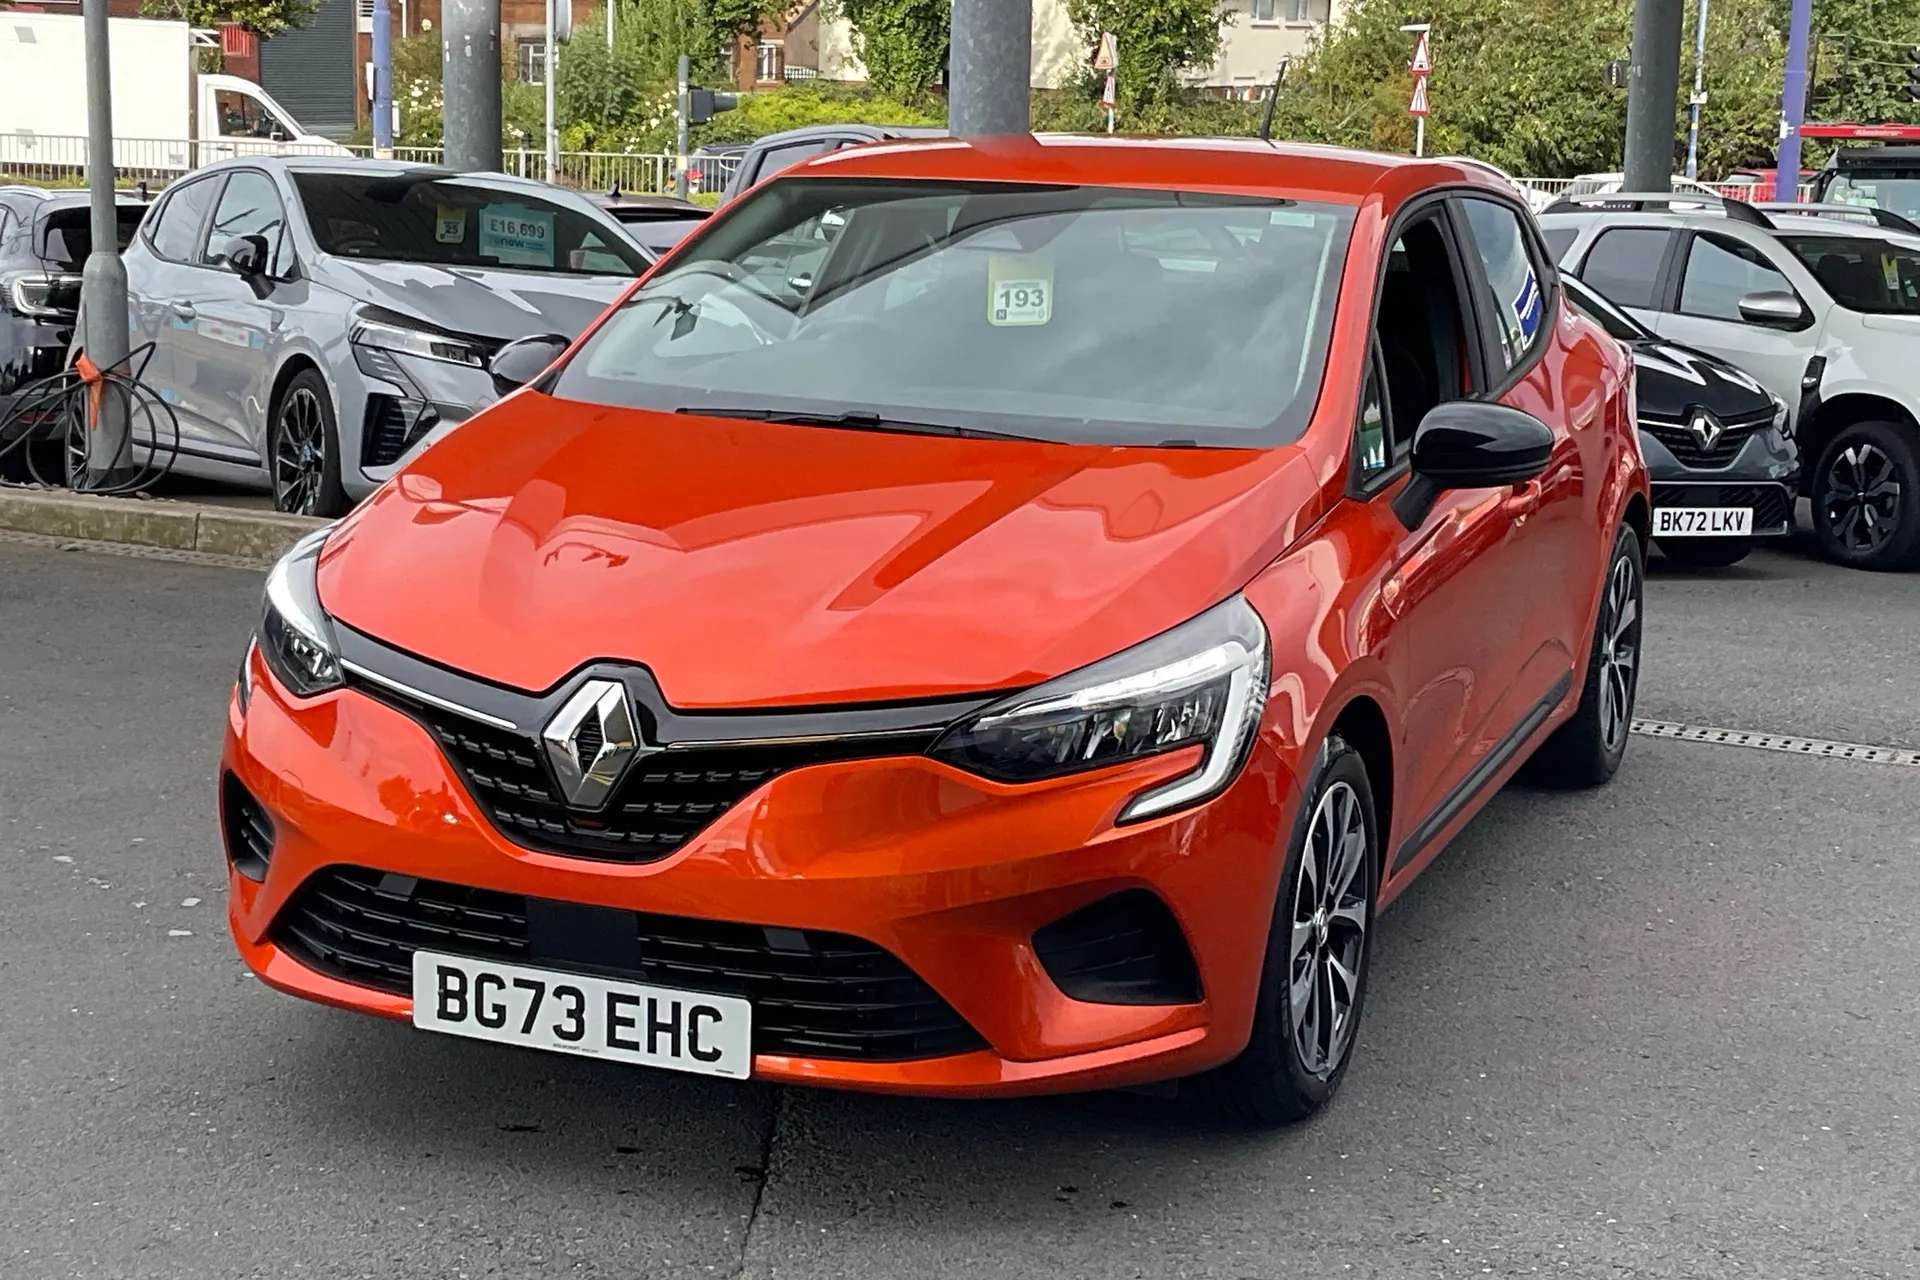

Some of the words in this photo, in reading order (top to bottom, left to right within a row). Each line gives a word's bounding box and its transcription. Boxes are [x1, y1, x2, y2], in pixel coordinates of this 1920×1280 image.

[1000, 288, 1044, 309] 193
[1660, 511, 1707, 532] BK72
[1711, 511, 1745, 532] LKV
[436, 965, 586, 1042] BG73
[605, 991, 723, 1063] EHC
